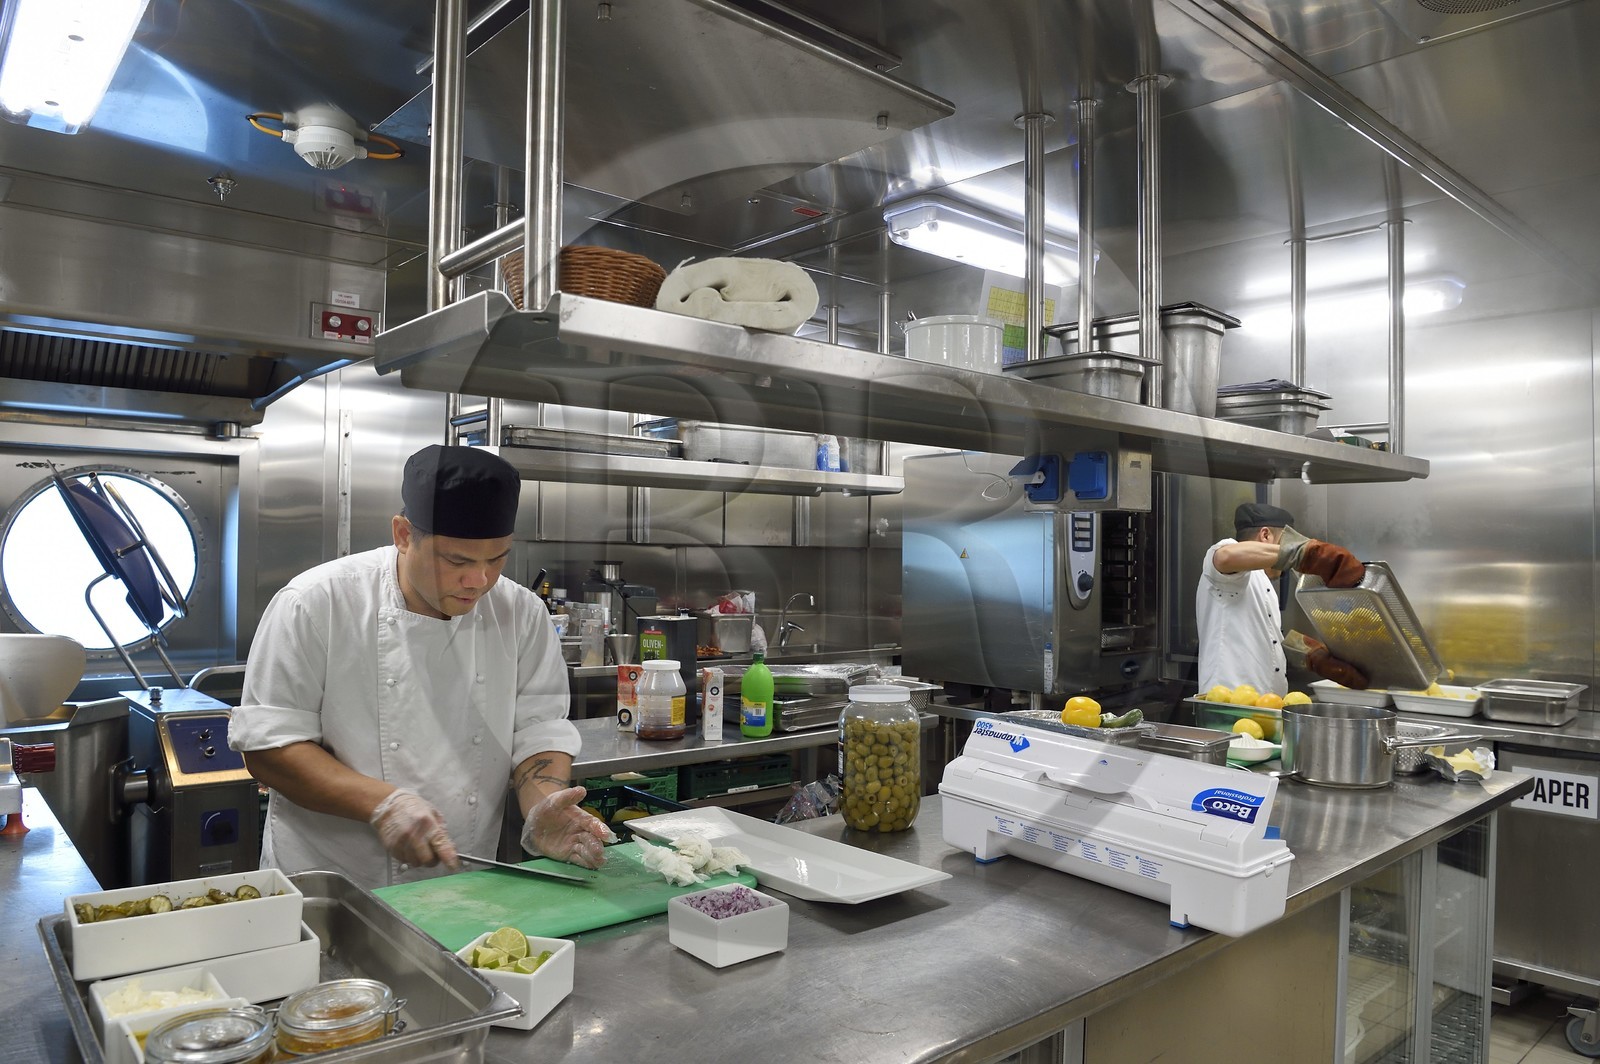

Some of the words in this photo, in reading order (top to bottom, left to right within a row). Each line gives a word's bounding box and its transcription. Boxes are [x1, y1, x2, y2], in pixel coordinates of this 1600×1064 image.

[976, 720, 993, 730] 4500
[973, 727, 1024, 747] Wrapmaster
[1213, 789, 1257, 803] Professional
[1519, 777, 1590, 810] APER
[1212, 800, 1252, 819] Baco
